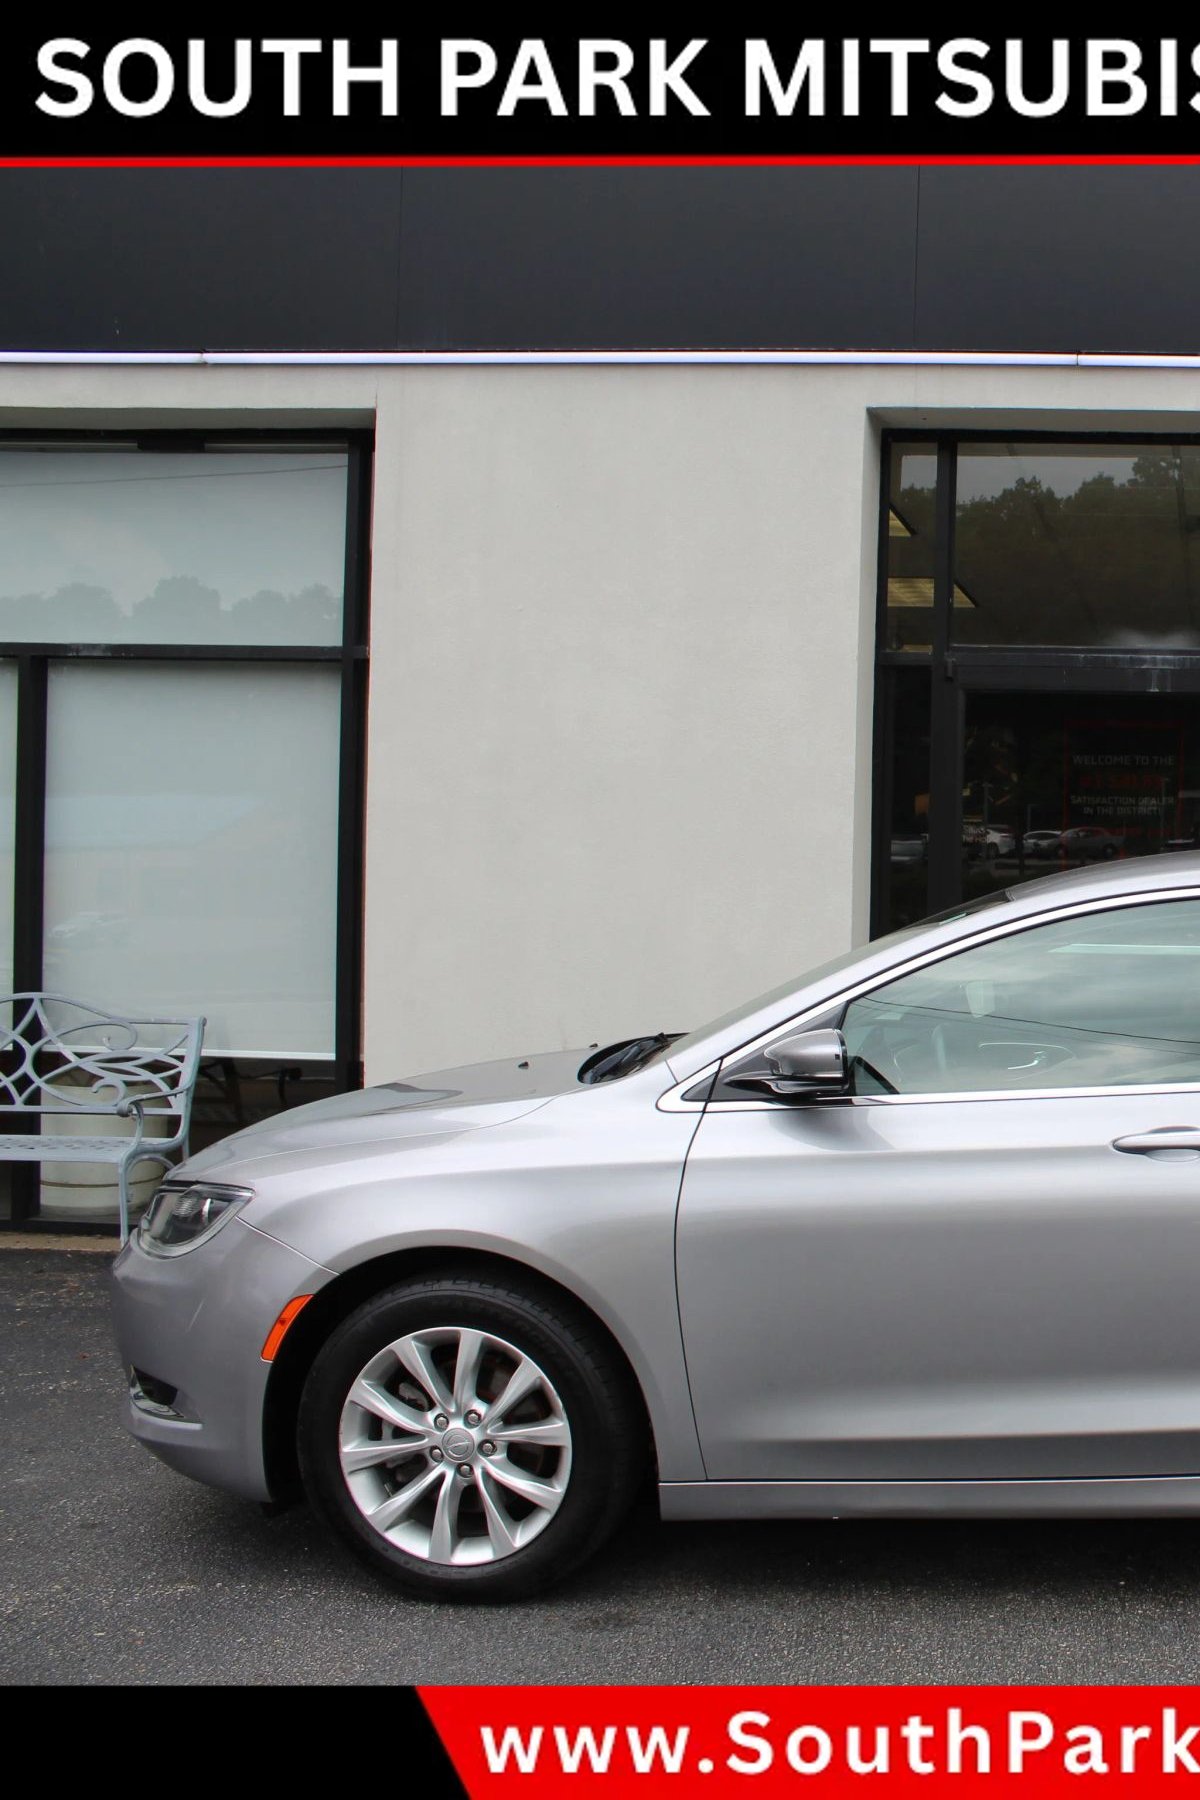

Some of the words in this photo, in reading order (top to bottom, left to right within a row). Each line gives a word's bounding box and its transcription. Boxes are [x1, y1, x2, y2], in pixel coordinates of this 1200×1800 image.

[1072, 754, 1133, 765] WELCOME
[1136, 755, 1149, 765] TO
[1154, 755, 1175, 765] THE
